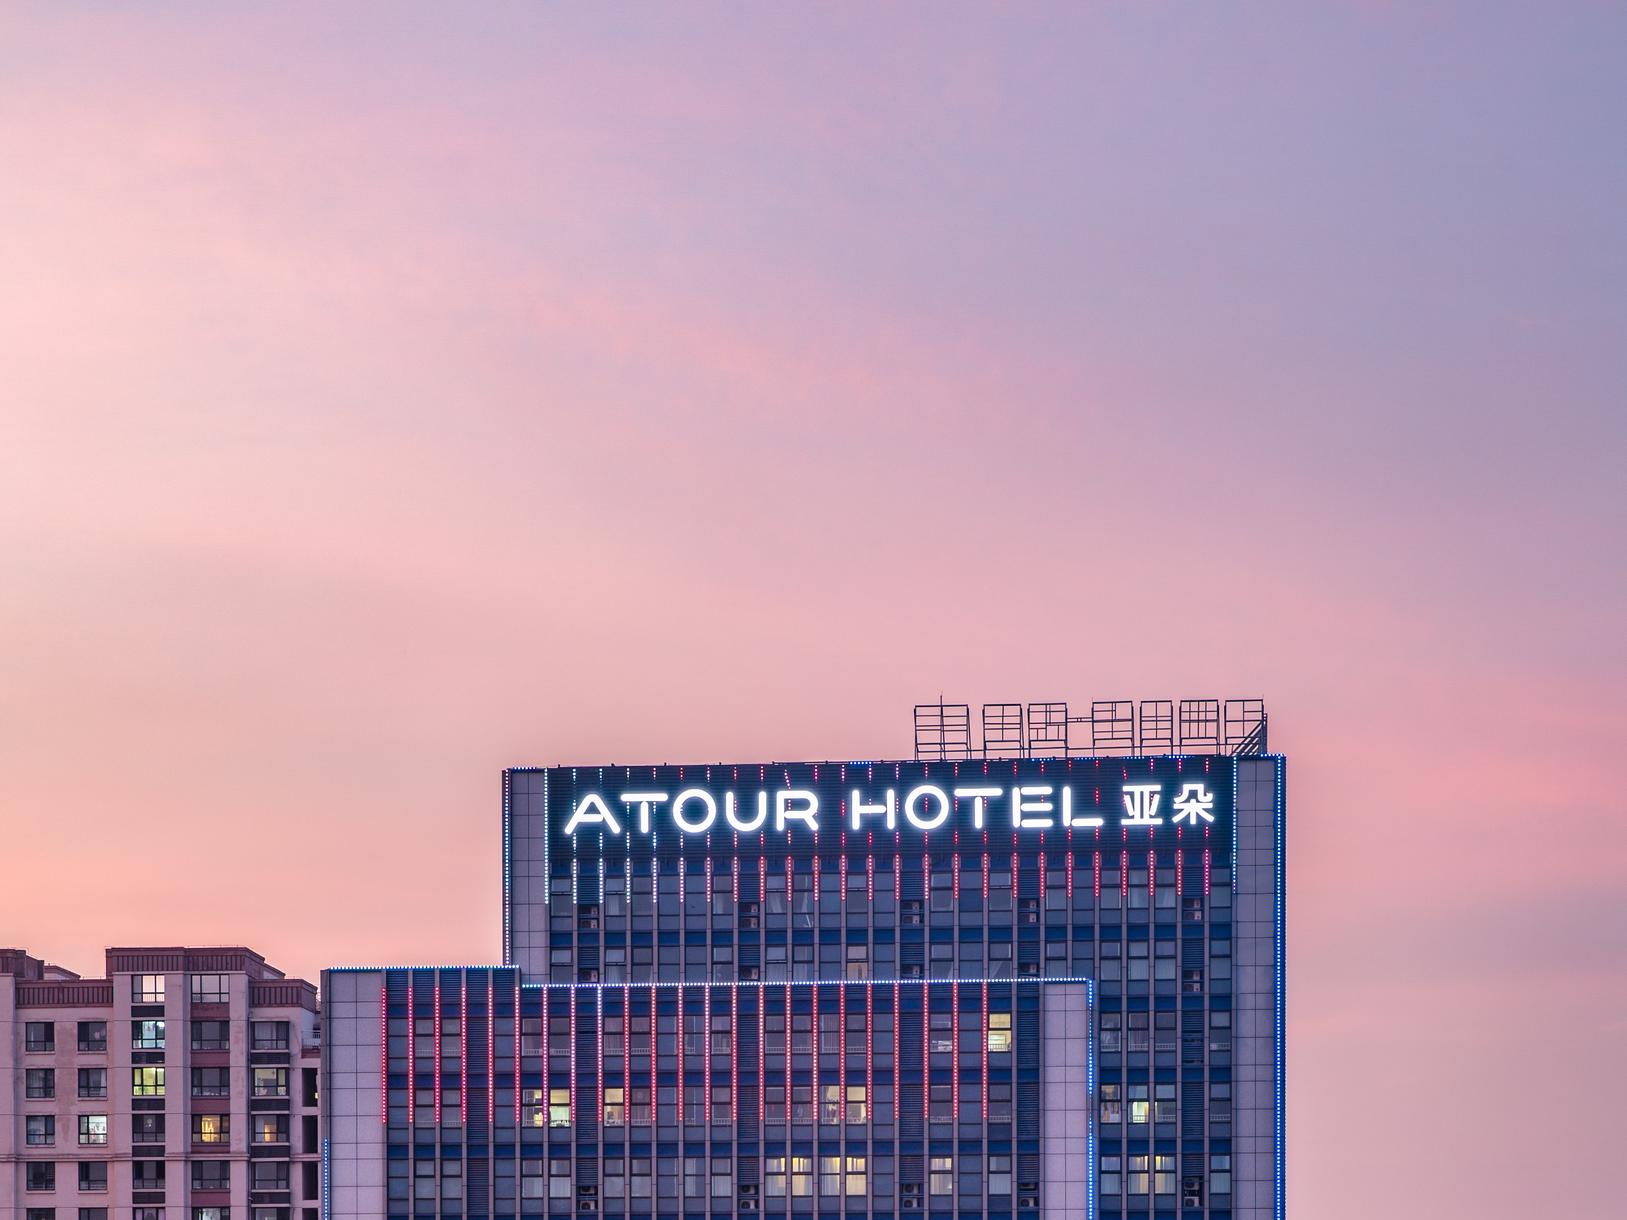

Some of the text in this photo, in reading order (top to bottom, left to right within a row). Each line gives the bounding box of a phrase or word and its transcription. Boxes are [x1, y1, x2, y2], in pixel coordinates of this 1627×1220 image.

[564, 784, 1104, 835] ATOUR HOTEL
[1120, 783, 1216, 826] 亚朵
